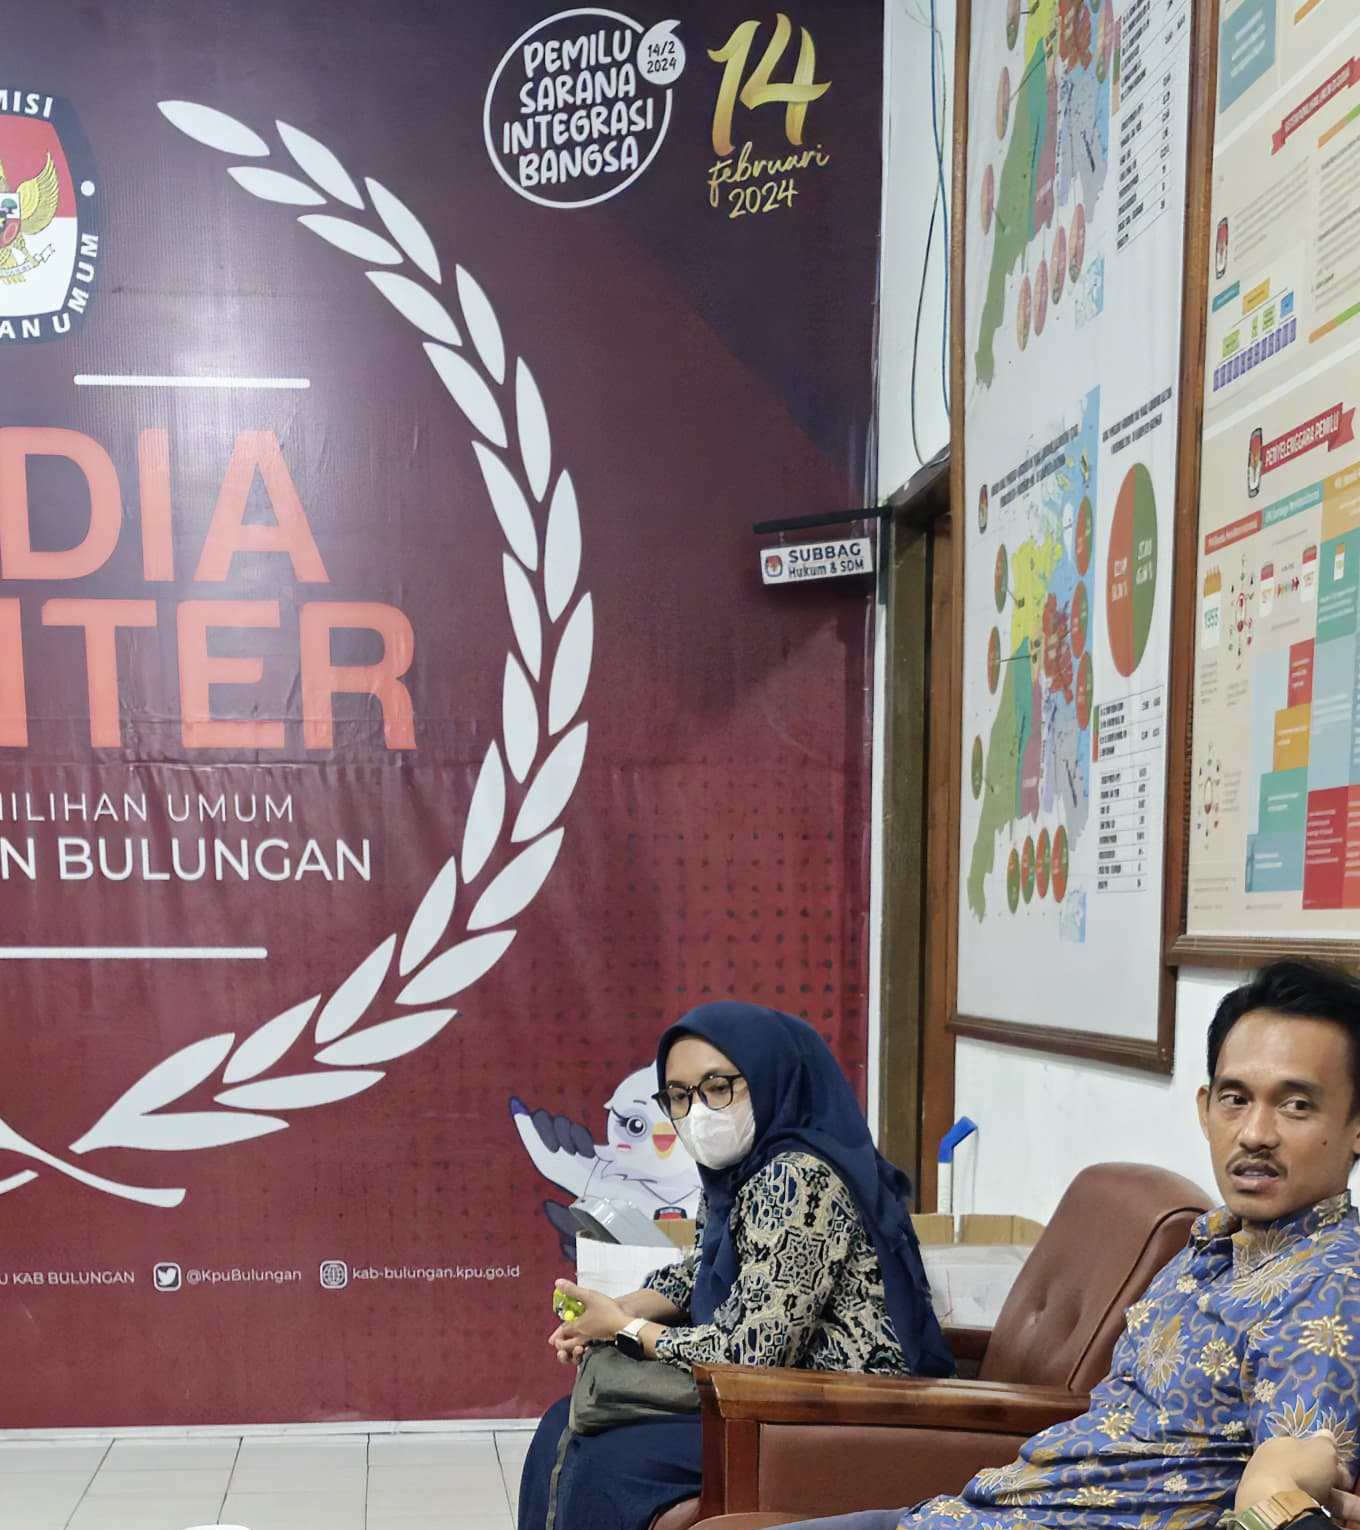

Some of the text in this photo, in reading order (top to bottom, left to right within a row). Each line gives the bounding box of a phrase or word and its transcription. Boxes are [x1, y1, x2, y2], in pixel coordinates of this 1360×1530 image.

[523, 29, 633, 78] PEMILU
[646, 57, 678, 74] 2024
[647, 40, 676, 58] 14/2
[520, 63, 636, 114] SARANA
[706, 13, 832, 156] 14
[503, 99, 655, 155] INTEGRASI
[519, 136, 640, 187] BANGSA
[728, 180, 798, 219] 2024
[51, 232, 100, 335] UMUM
[788, 542, 861, 563] SUBBAG
[788, 564, 827, 578] Hukum
[840, 559, 864, 573] SDM
[171, 793, 295, 823] UMUM
[58, 836, 371, 882] BULUNGAN
[13, 1271, 44, 1285] KAB
[47, 1269, 135, 1285] BULUNGAN
[186, 1267, 301, 1284] @KpuBulungan
[352, 1264, 520, 1281] kab-bulungan.kpu.go.id
